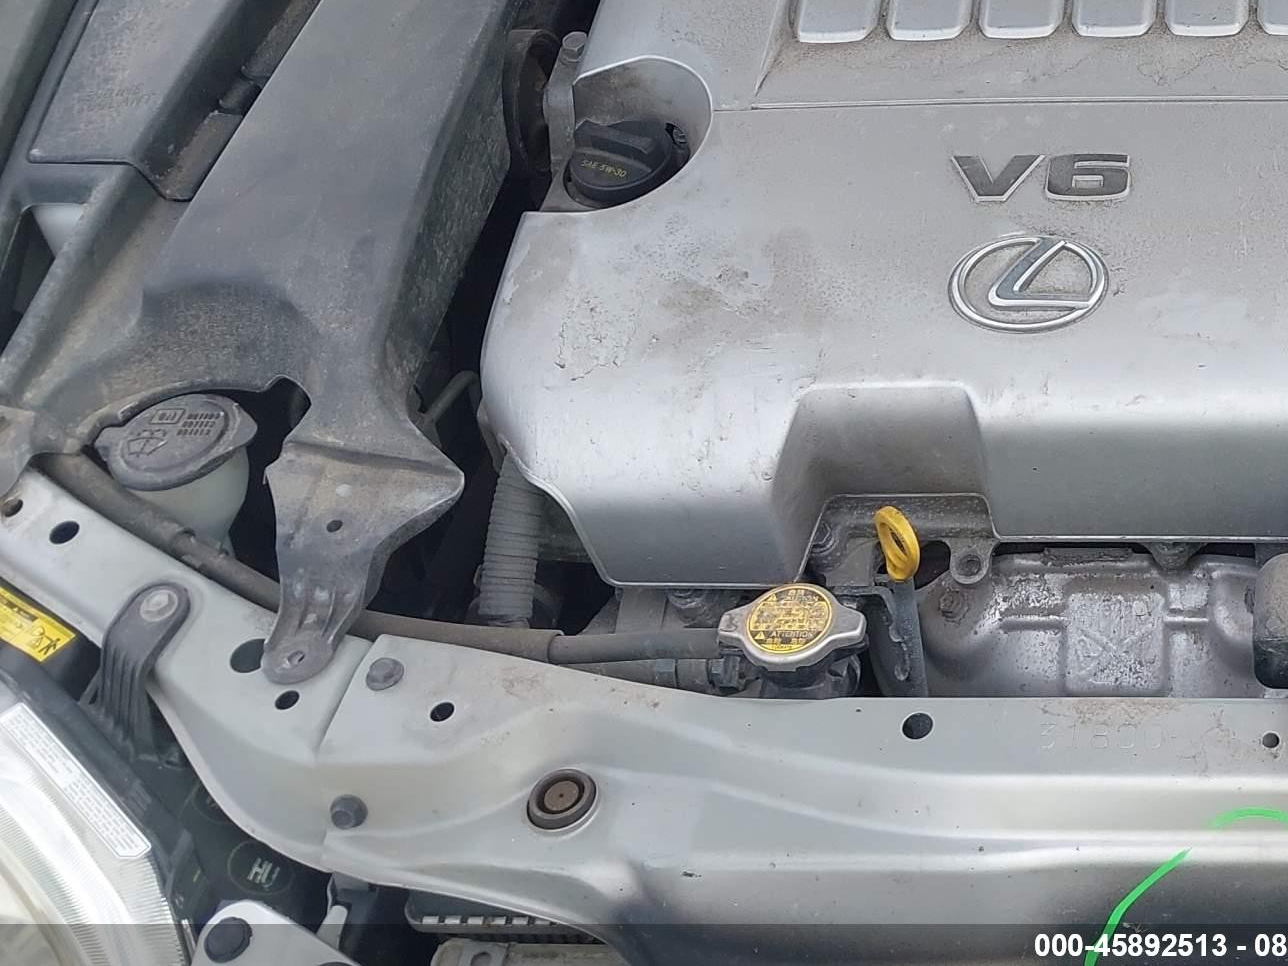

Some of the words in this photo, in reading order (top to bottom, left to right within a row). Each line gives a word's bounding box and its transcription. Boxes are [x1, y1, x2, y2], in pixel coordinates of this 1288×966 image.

[580, 159, 599, 169] SAE
[599, 163, 628, 178] 5W-30
[950, 152, 1131, 203] V6
